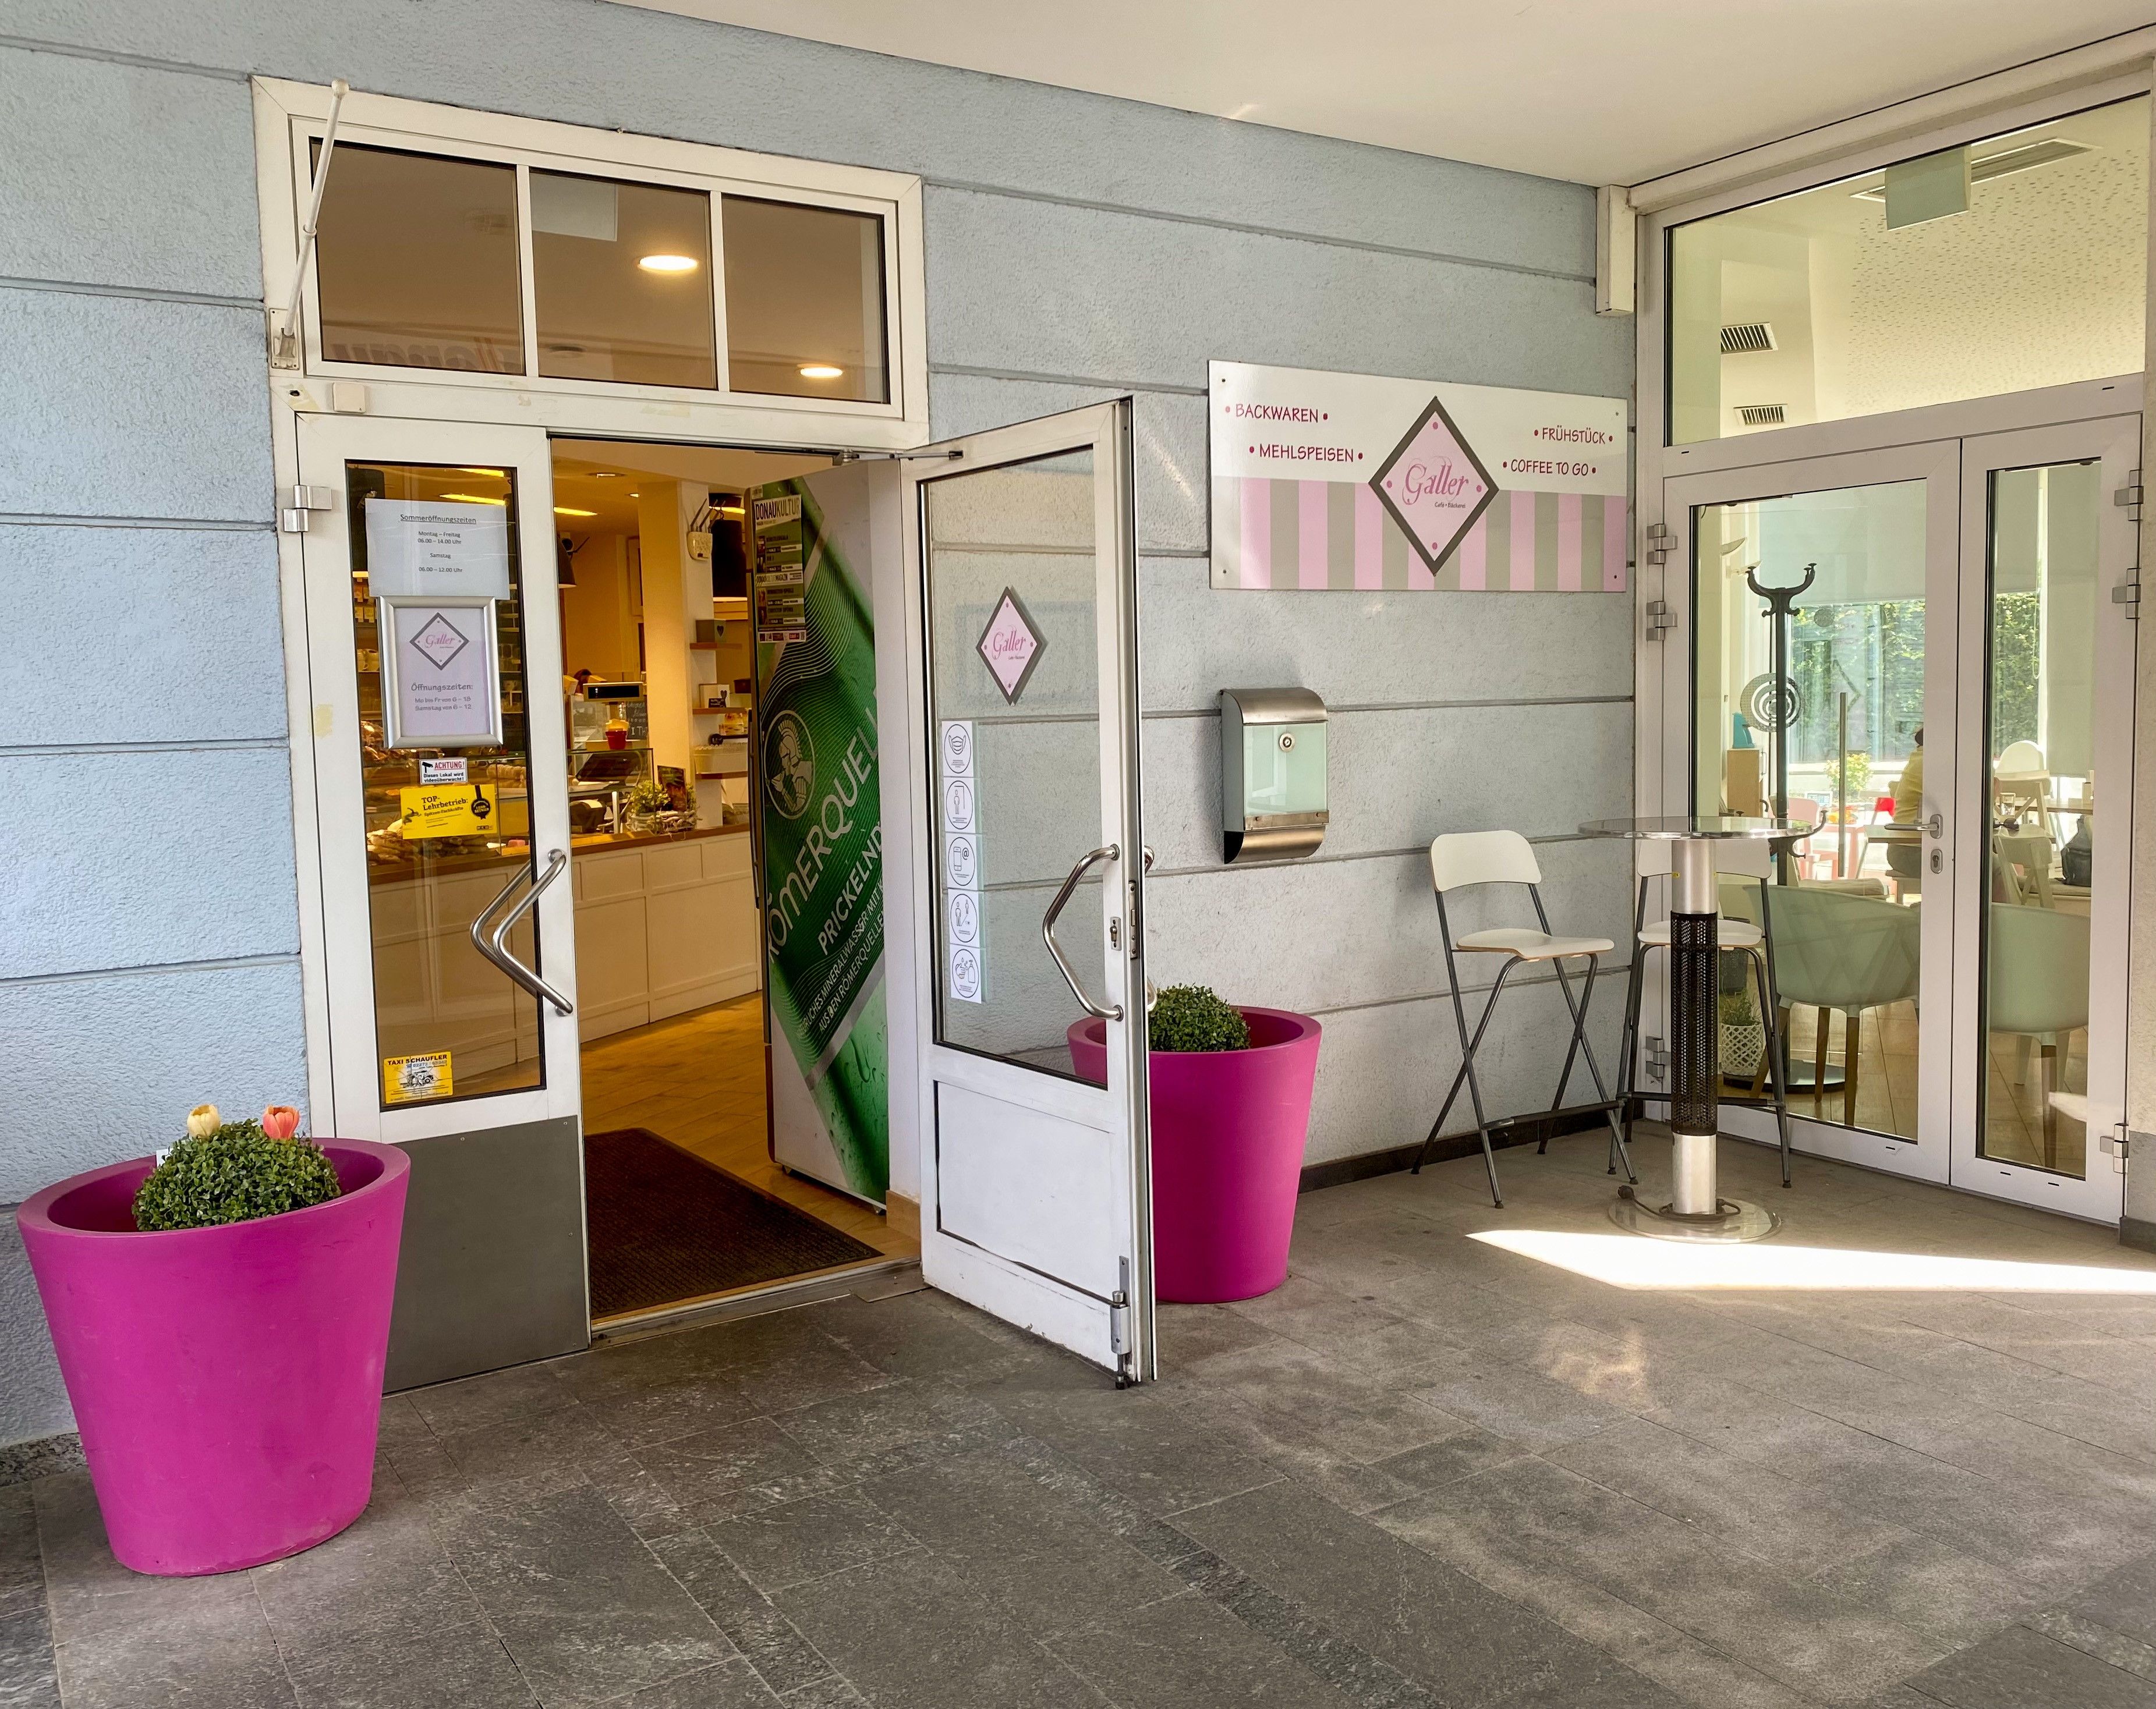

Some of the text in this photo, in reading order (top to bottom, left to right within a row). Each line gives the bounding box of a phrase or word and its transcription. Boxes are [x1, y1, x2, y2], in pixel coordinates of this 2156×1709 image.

[1235, 403, 1318, 423] BACKWAREN
[1542, 425, 1606, 444] FRÜHSTÜCK
[1259, 444, 1354, 462] MEHLSPEISEN
[1511, 459, 1589, 476] COFFEE TO GO
[1402, 459, 1469, 505] Galler
[755, 498, 800, 520] DONAUKULTUR
[401, 514, 477, 524] Sommeröffnungszeiten
[992, 627, 1026, 660] Galler
[411, 682, 473, 692] Öffnungszeiten:
[423, 798, 468, 810] Lehrbetrieb:
[818, 821, 881, 956] PRICKELND
[866, 888, 880, 915] MIT
[819, 911, 884, 1034] AUS DEN RÖMERQUELLE
[405, 1054, 447, 1064] SCHAUFLER
